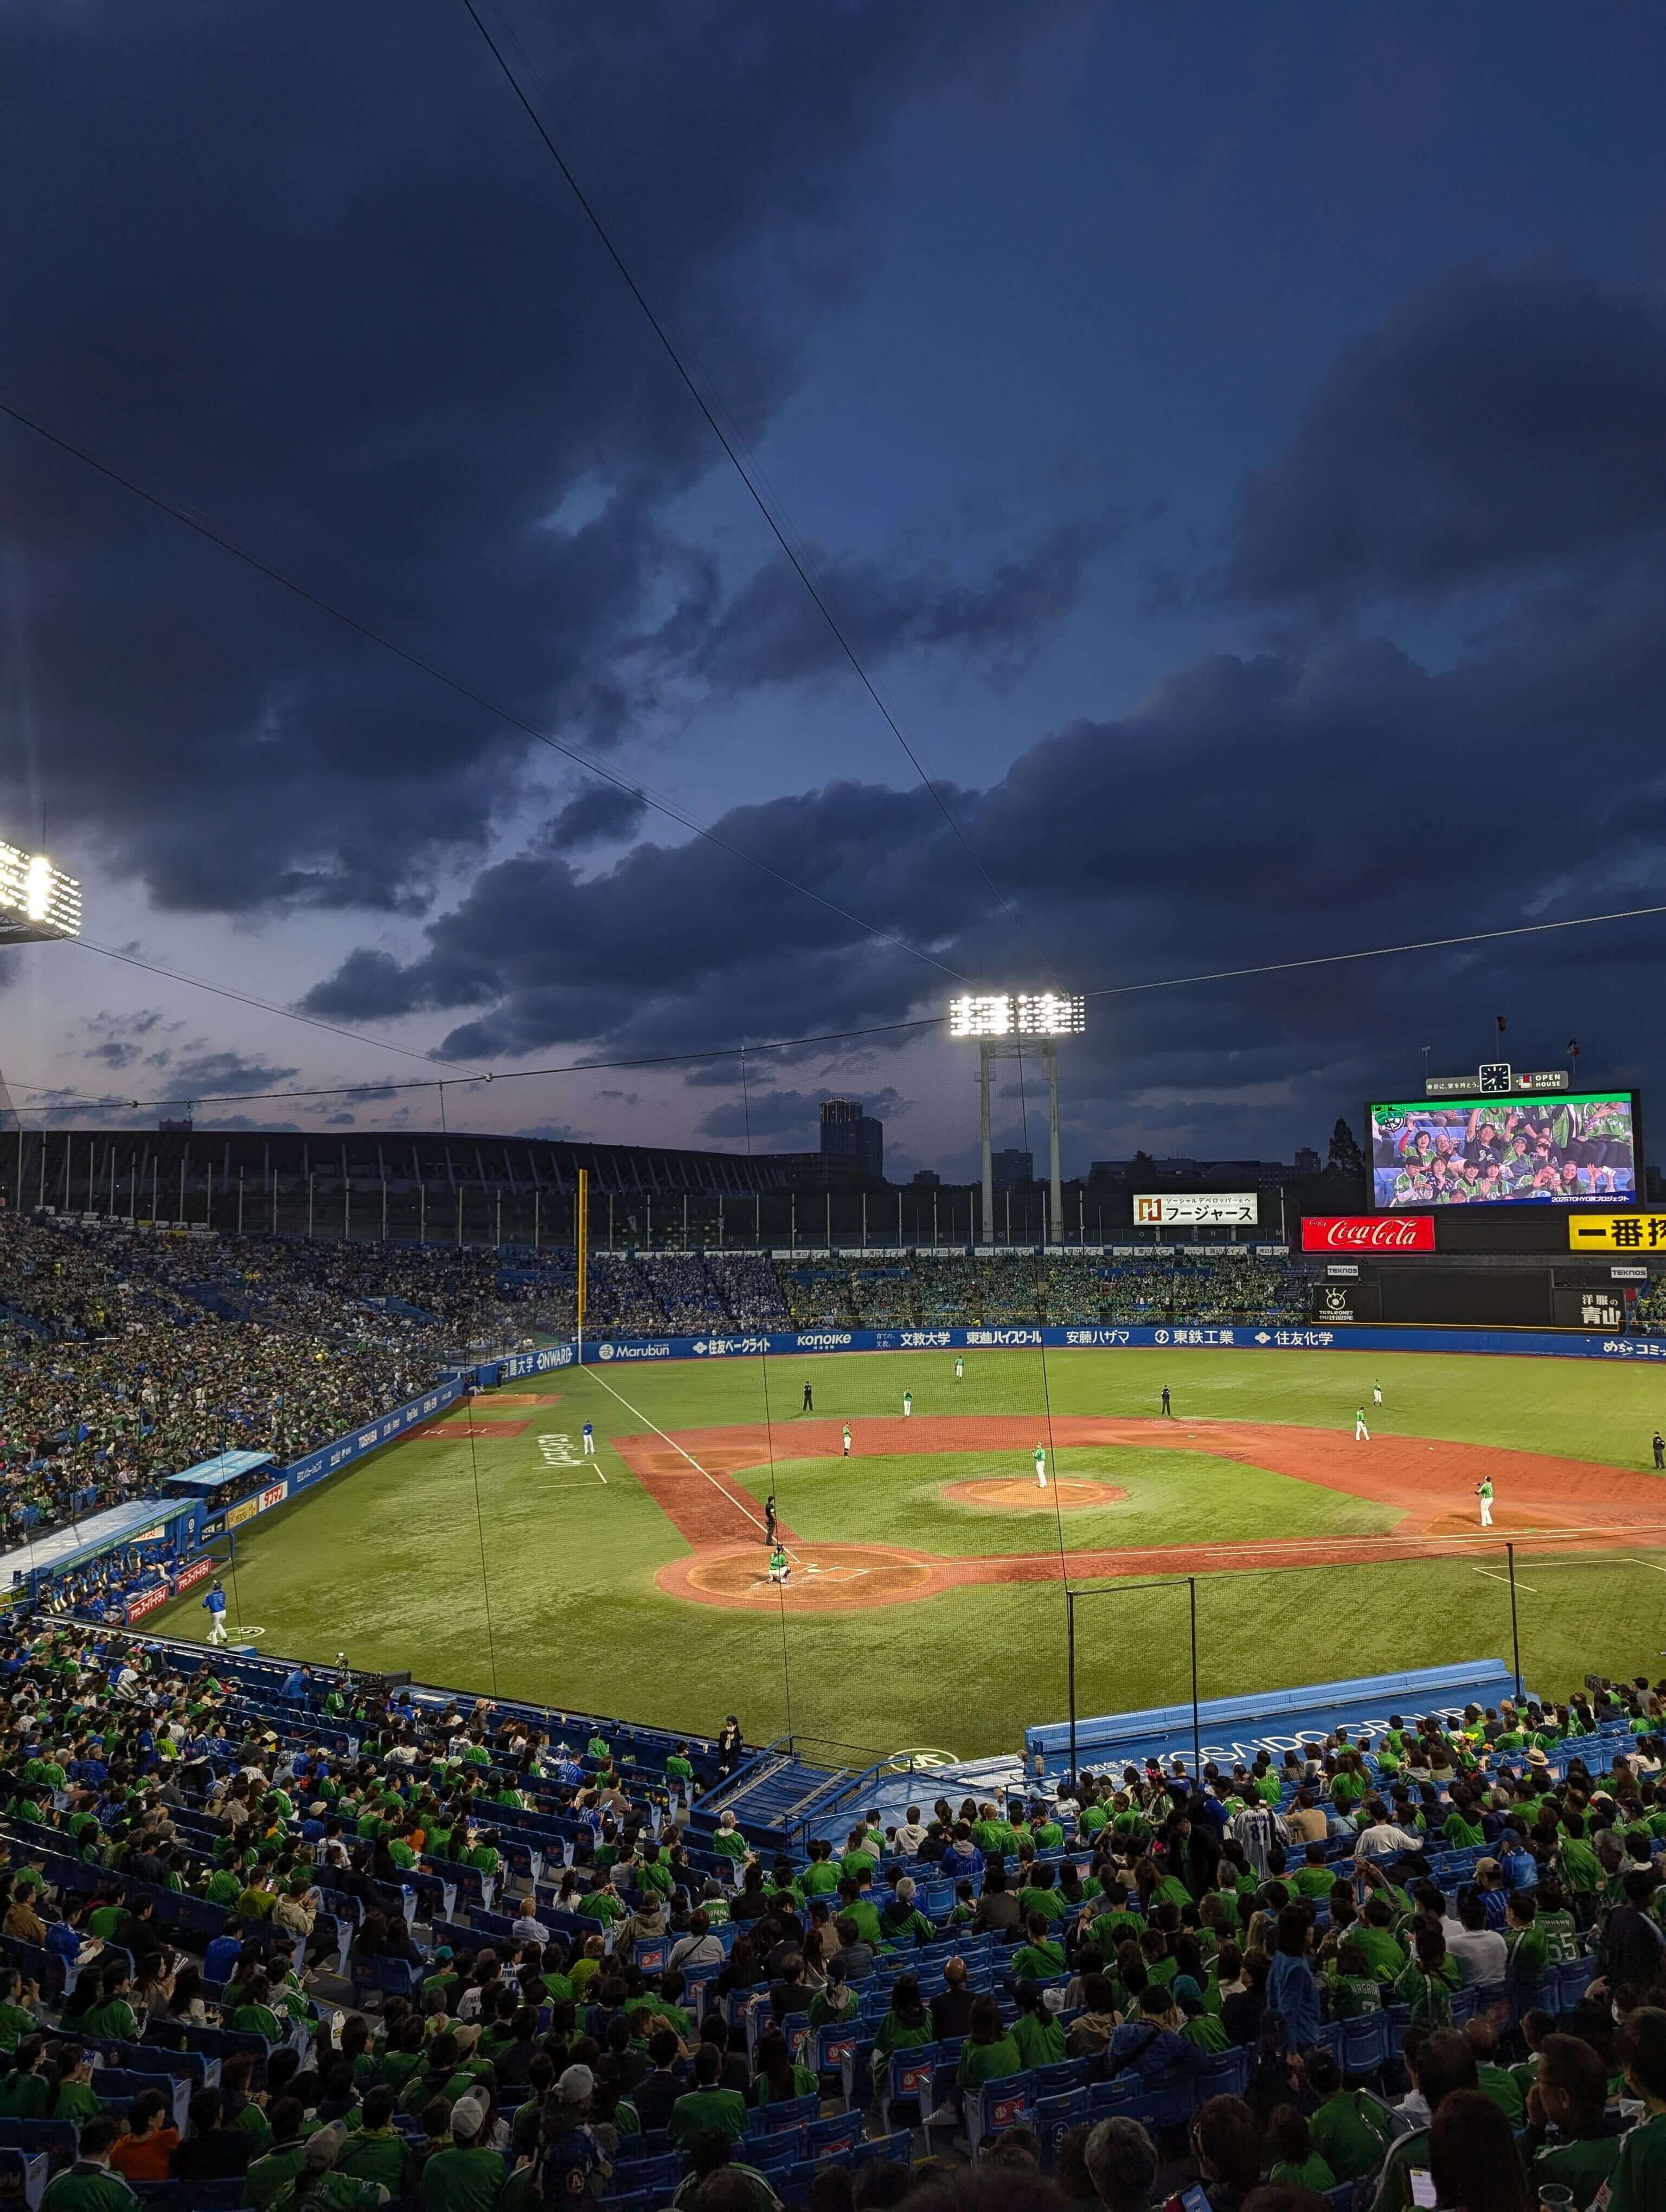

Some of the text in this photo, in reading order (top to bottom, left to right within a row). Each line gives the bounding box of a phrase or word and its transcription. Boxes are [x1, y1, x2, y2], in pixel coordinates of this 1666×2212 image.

[1166, 1205, 1253, 1221] フージャース
[1327, 1220, 1418, 1245] Coca-Cola
[1582, 1294, 1618, 1306] 洋服の
[1581, 1306, 1621, 1325] 青山
[900, 1332, 951, 1347] 文教大学
[966, 1331, 1042, 1345] 東進ハイスクール
[1066, 1330, 1129, 1345] 安藤ハザマ
[1174, 1329, 1234, 1345] 東鉄工業
[1274, 1331, 1334, 1346] 住友化学
[616, 1344, 669, 1358] Marubun
[708, 1337, 770, 1354] 住友ベークライト
[537, 1347, 573, 1370] ONWARD
[1251, 1824, 1267, 1841] 81
[958, 1861, 972, 1877] 11
[1546, 1932, 1577, 1962] 55
[1352, 1984, 1380, 1996] NAGAOK
